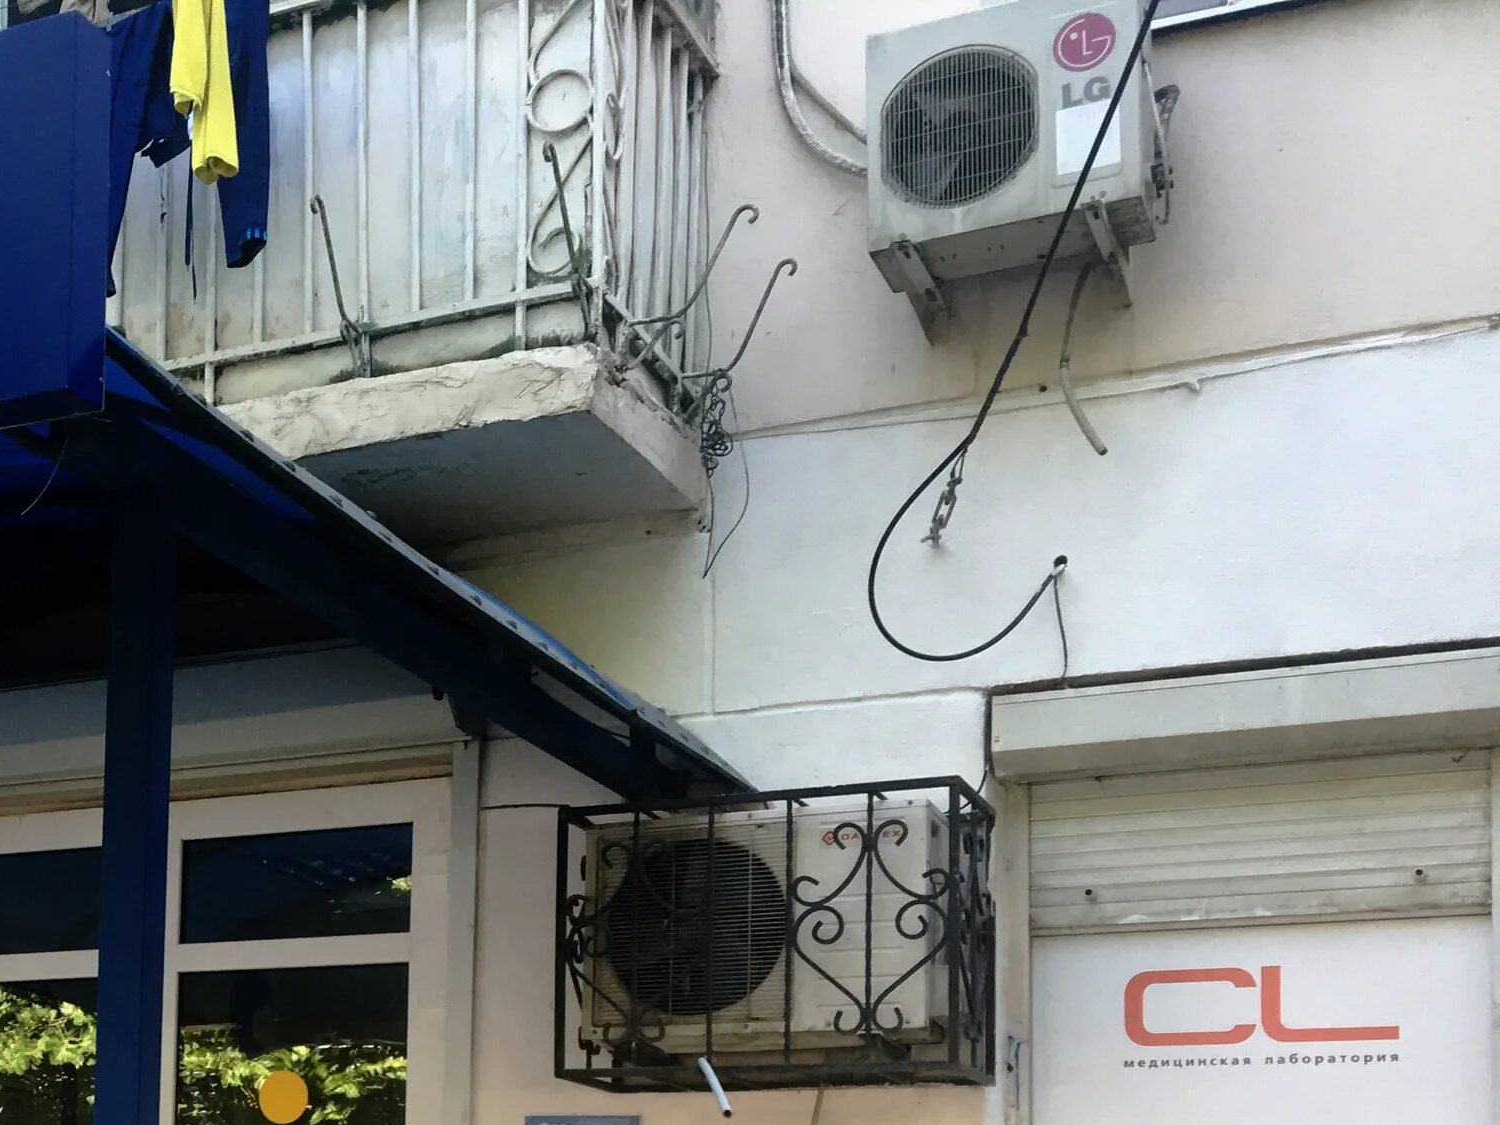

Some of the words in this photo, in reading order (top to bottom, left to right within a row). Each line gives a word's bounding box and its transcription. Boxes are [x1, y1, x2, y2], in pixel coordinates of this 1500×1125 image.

[1061, 76, 1111, 110] LG
[1124, 965, 1400, 1047] CL
[1123, 1055, 1252, 1069] медицинская
[1264, 1052, 1400, 1066] лаборатория
